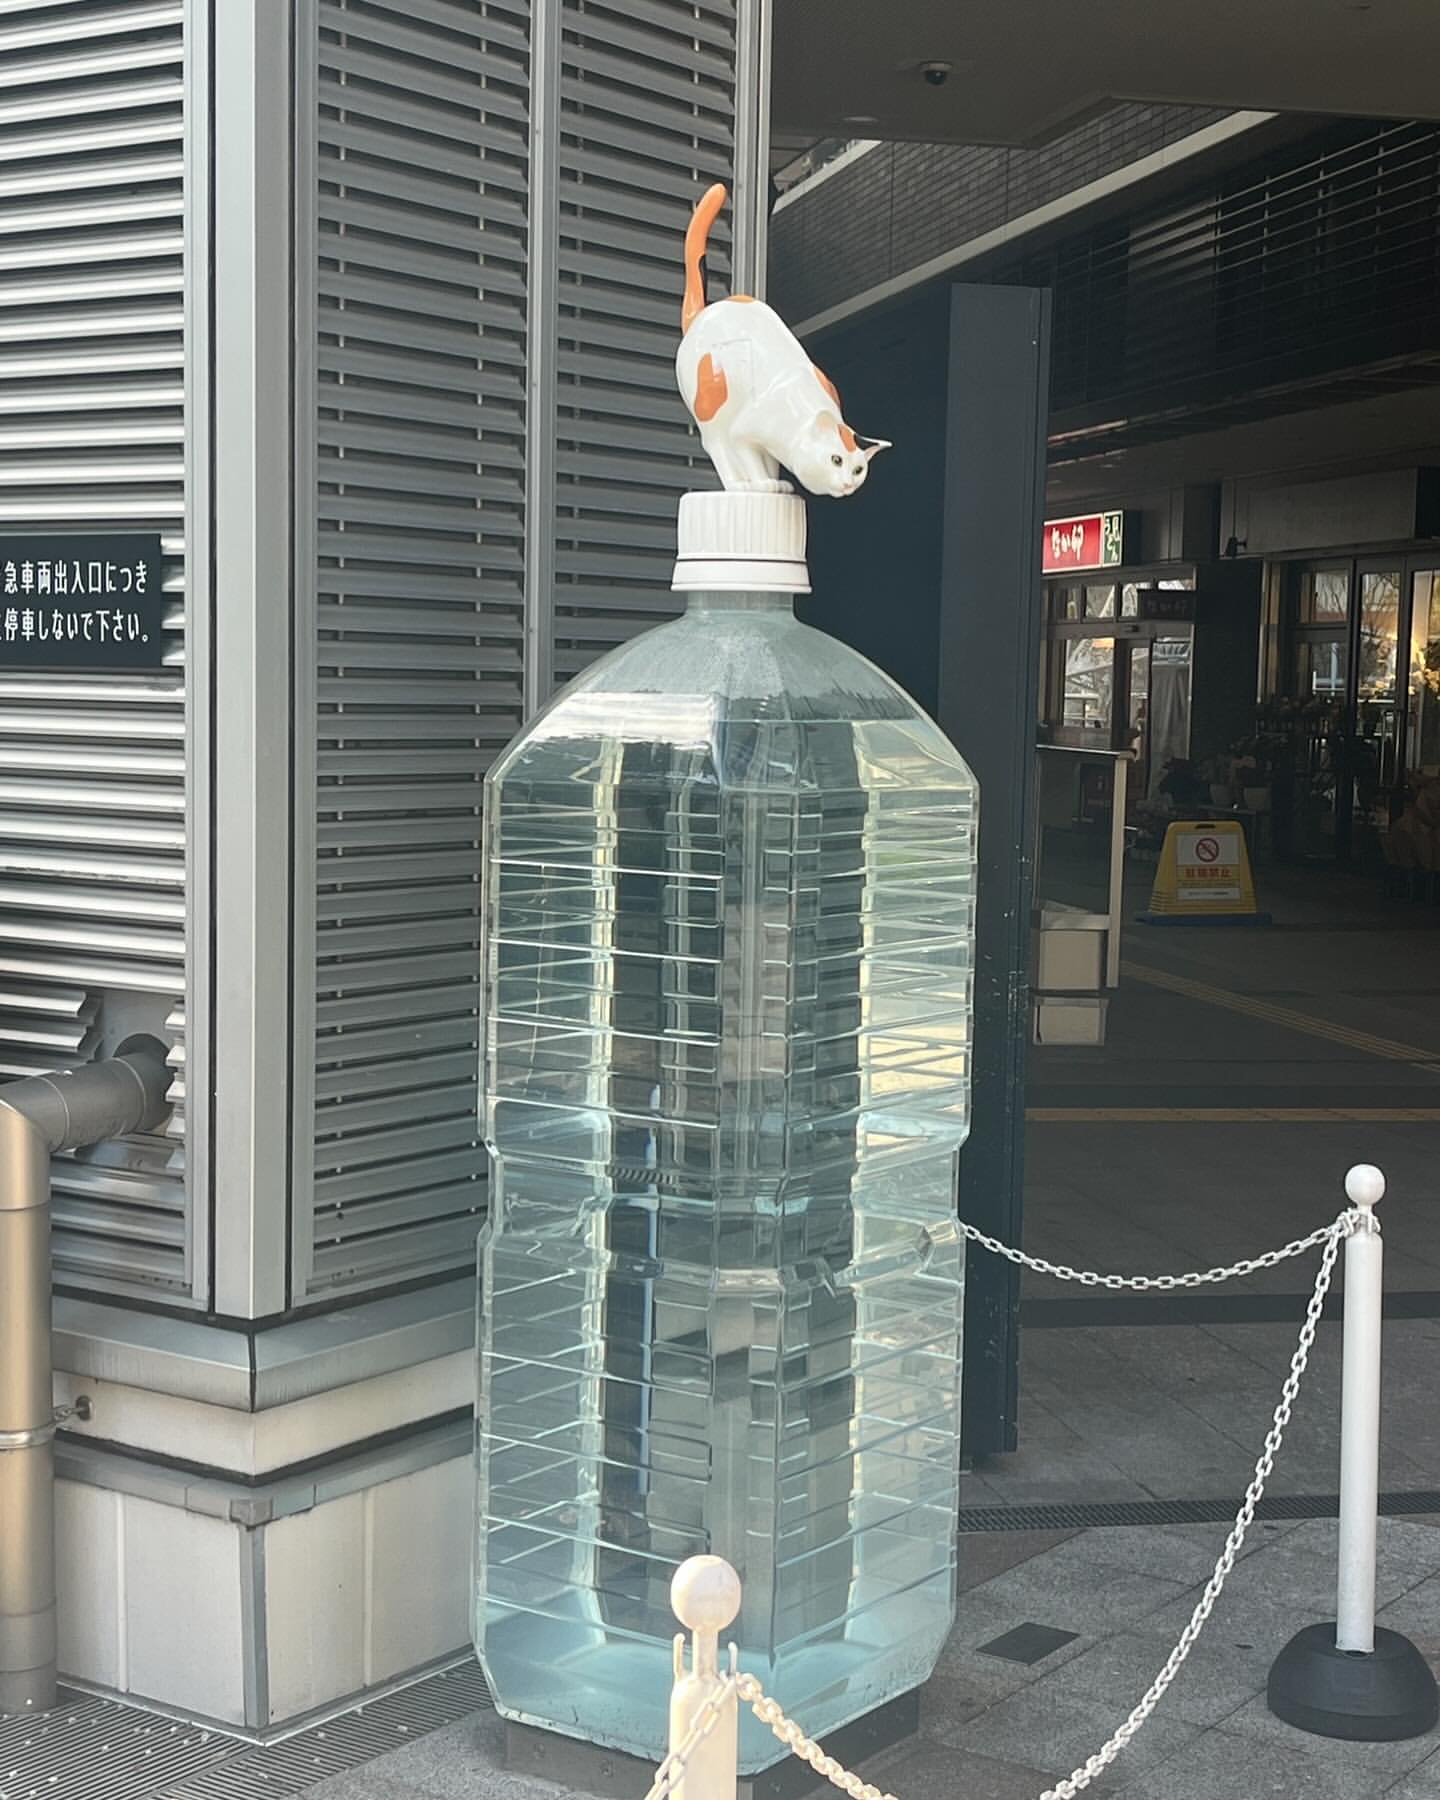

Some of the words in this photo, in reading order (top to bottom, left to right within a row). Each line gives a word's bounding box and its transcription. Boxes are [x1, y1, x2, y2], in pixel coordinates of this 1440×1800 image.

[1051, 524, 1084, 560] なか卯
[4, 560, 147, 594] 急車両出入口につき
[0, 608, 149, 642] 停車しないで下さい。
